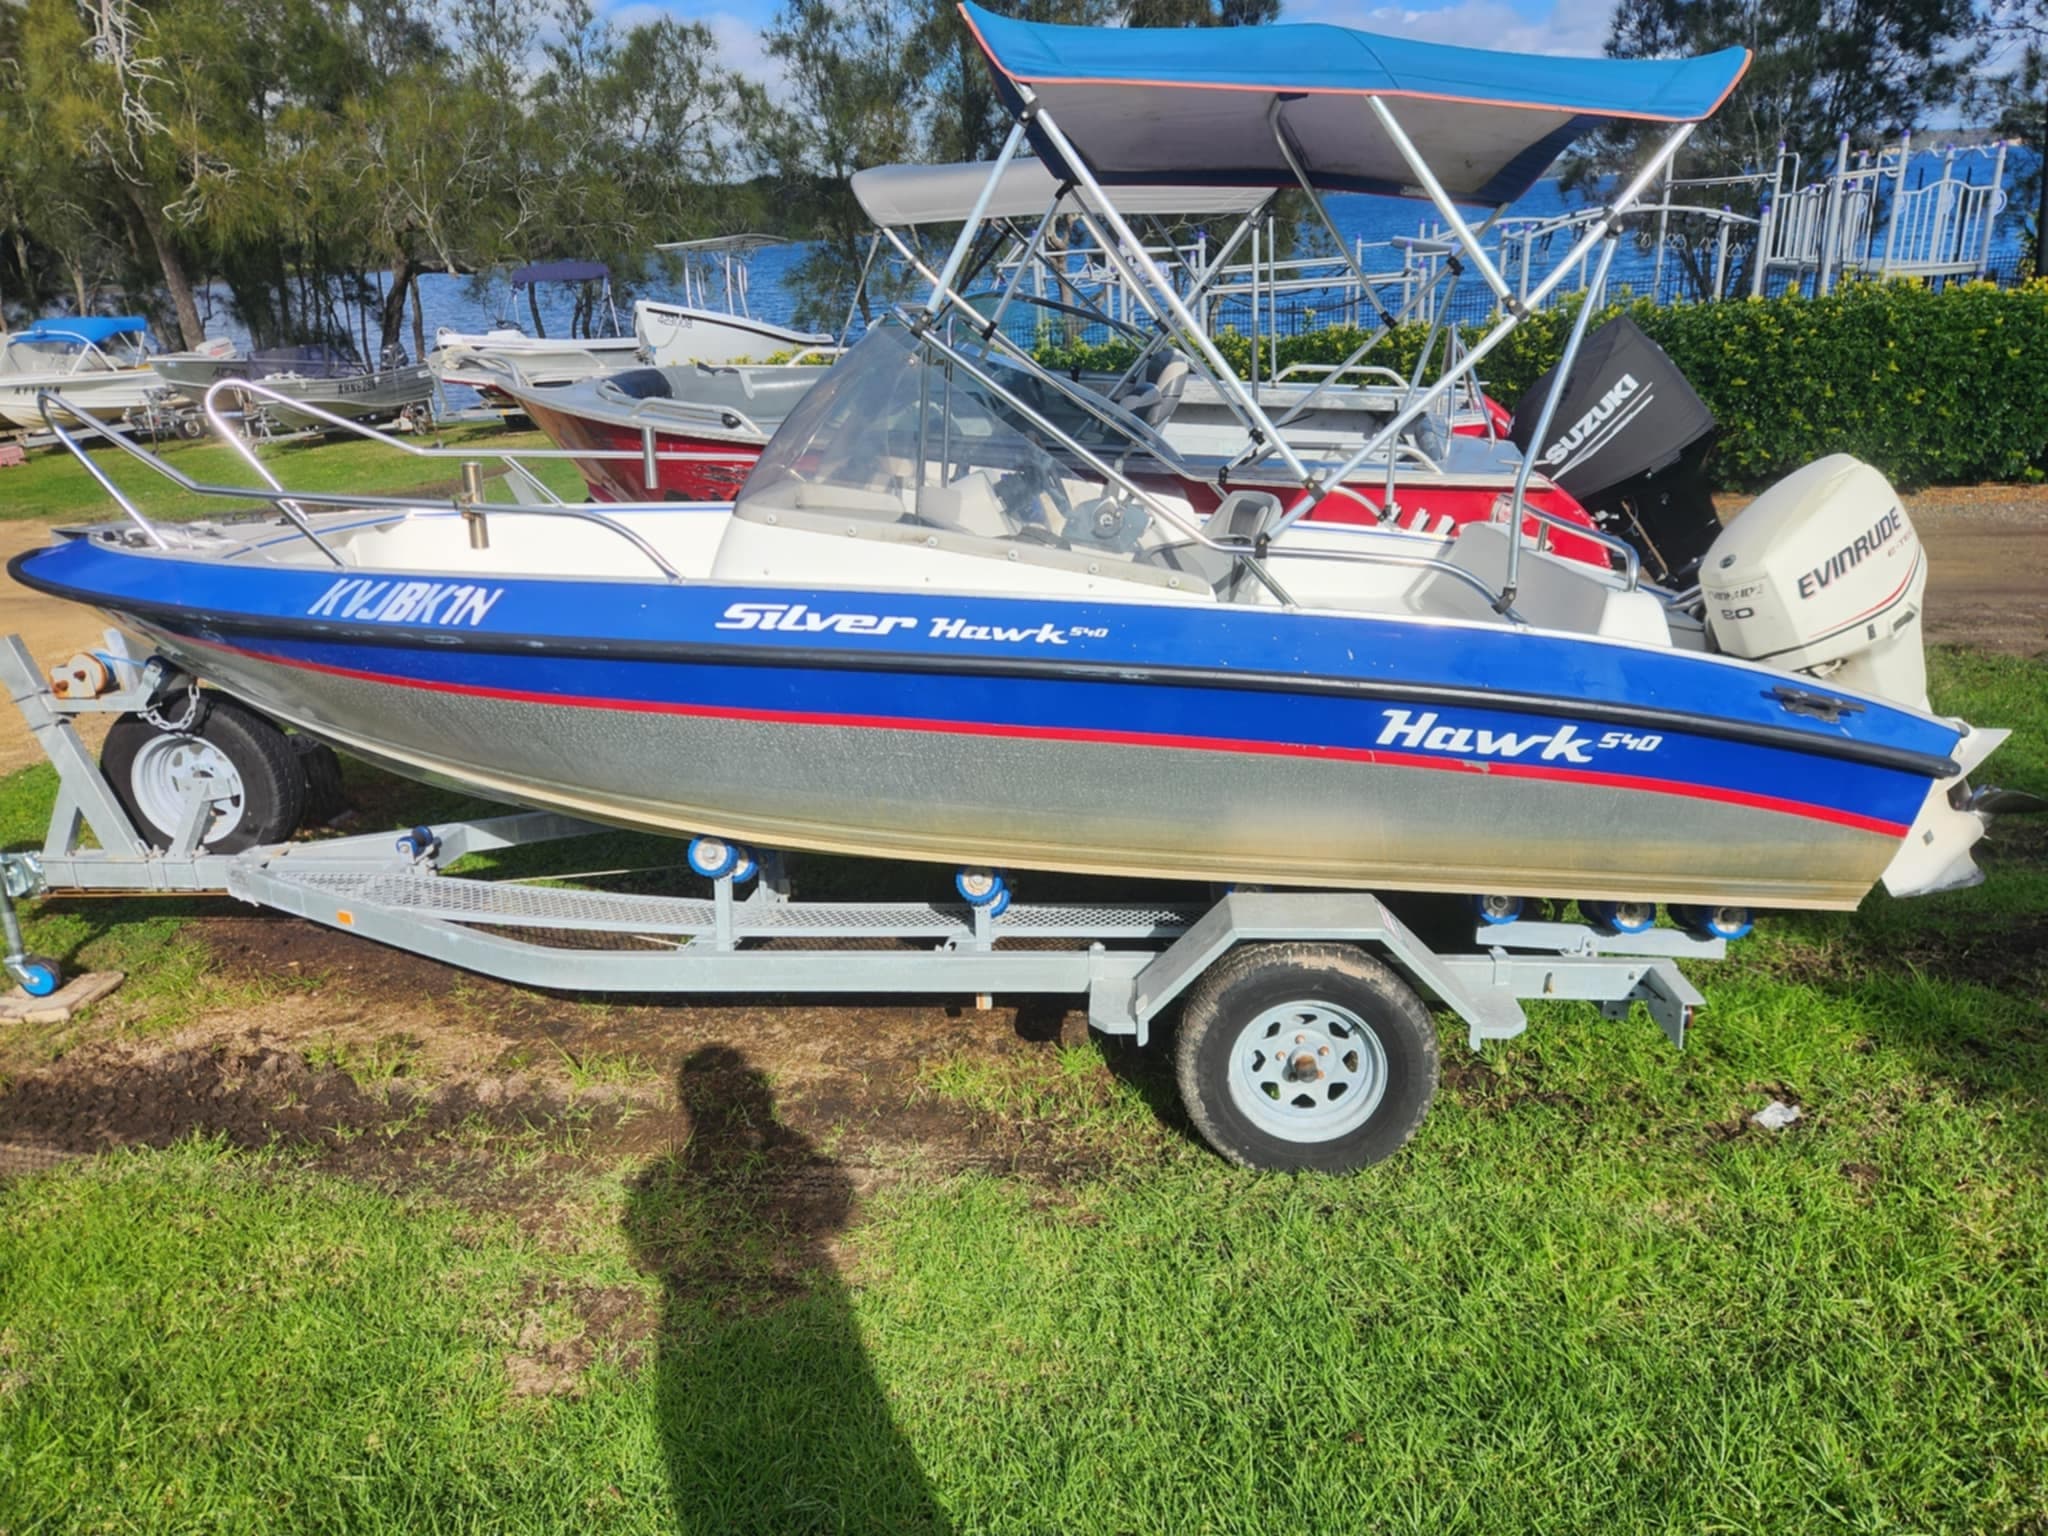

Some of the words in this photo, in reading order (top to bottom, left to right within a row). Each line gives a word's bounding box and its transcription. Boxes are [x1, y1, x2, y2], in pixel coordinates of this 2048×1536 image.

[1545, 373, 1639, 465] SUZUKI
[1797, 506, 1901, 599] EVINRUDE
[715, 603, 918, 635] Silver
[928, 617, 1069, 645] Hawk
[1069, 626, 1109, 638] 540
[1375, 709, 1594, 763] Hawk
[1597, 732, 1663, 752] 540
